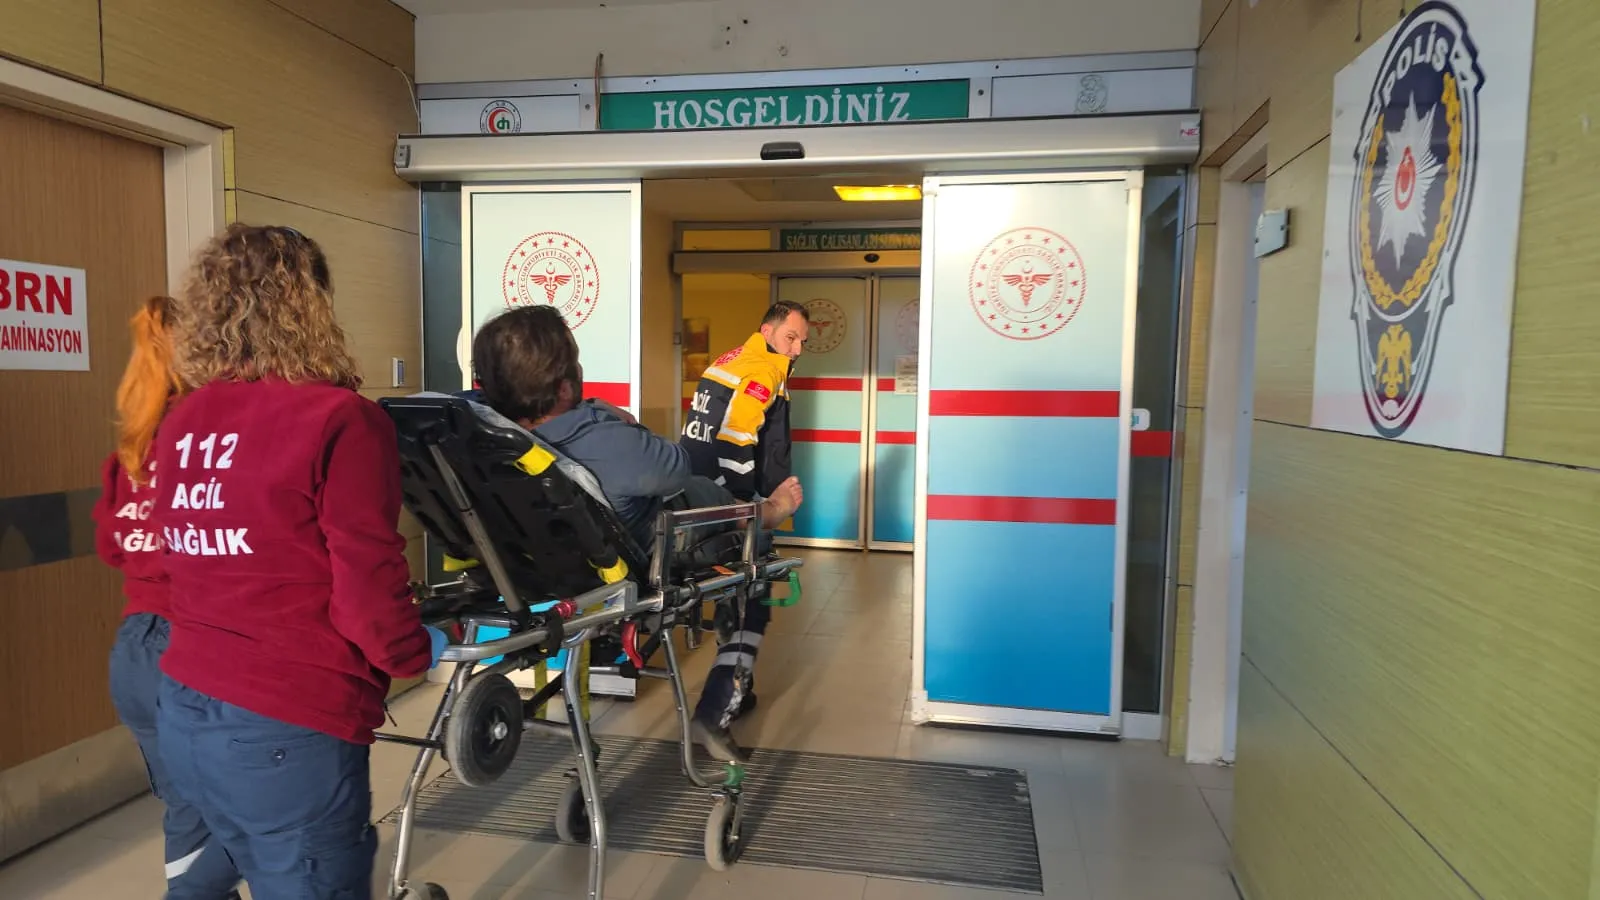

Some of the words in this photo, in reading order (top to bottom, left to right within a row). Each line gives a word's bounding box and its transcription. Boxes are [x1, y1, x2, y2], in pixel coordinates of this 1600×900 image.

[1382, 22, 1448, 107] POLİS
[0, 319, 82, 353] AMİNASYON
[681, 415, 714, 444] ĞLIK
[175, 432, 239, 469] 112
[171, 477, 225, 510] ACİL
[163, 522, 254, 556] SAĞLIK
